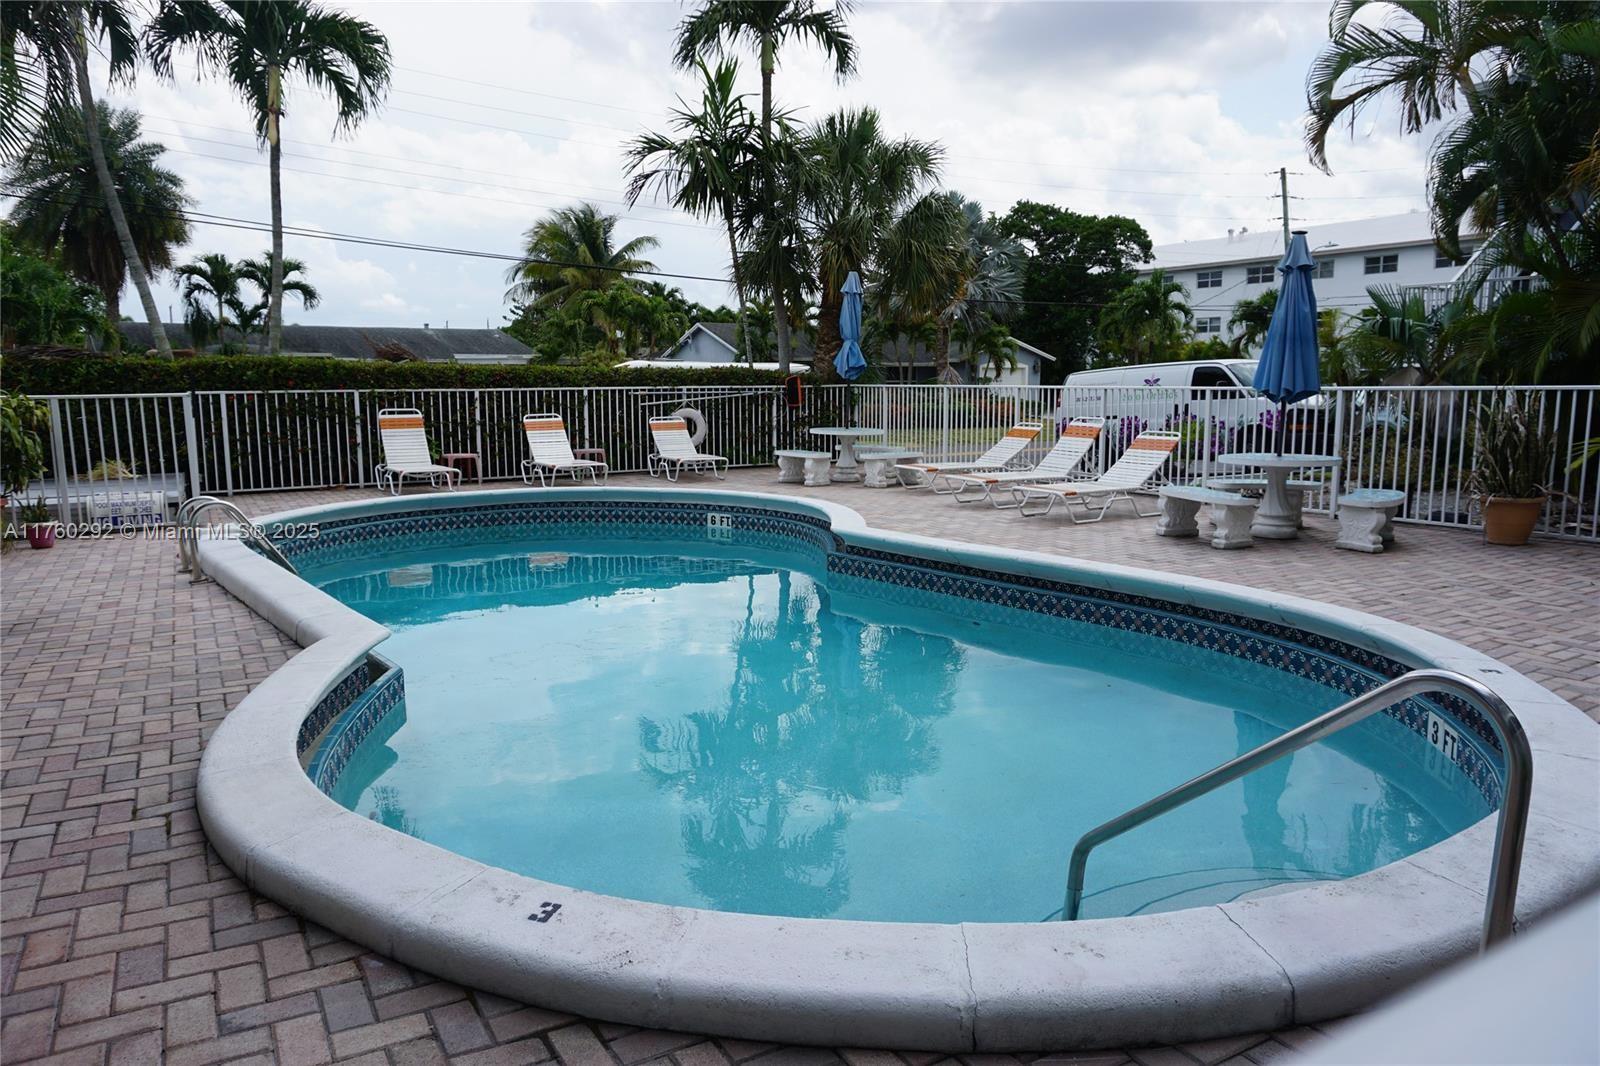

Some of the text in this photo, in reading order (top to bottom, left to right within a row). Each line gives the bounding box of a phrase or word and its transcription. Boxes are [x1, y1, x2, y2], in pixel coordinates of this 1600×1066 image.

[710, 515, 731, 527] 6 FT
[1431, 721, 1456, 761] 3 FT
[528, 902, 562, 923] 3
